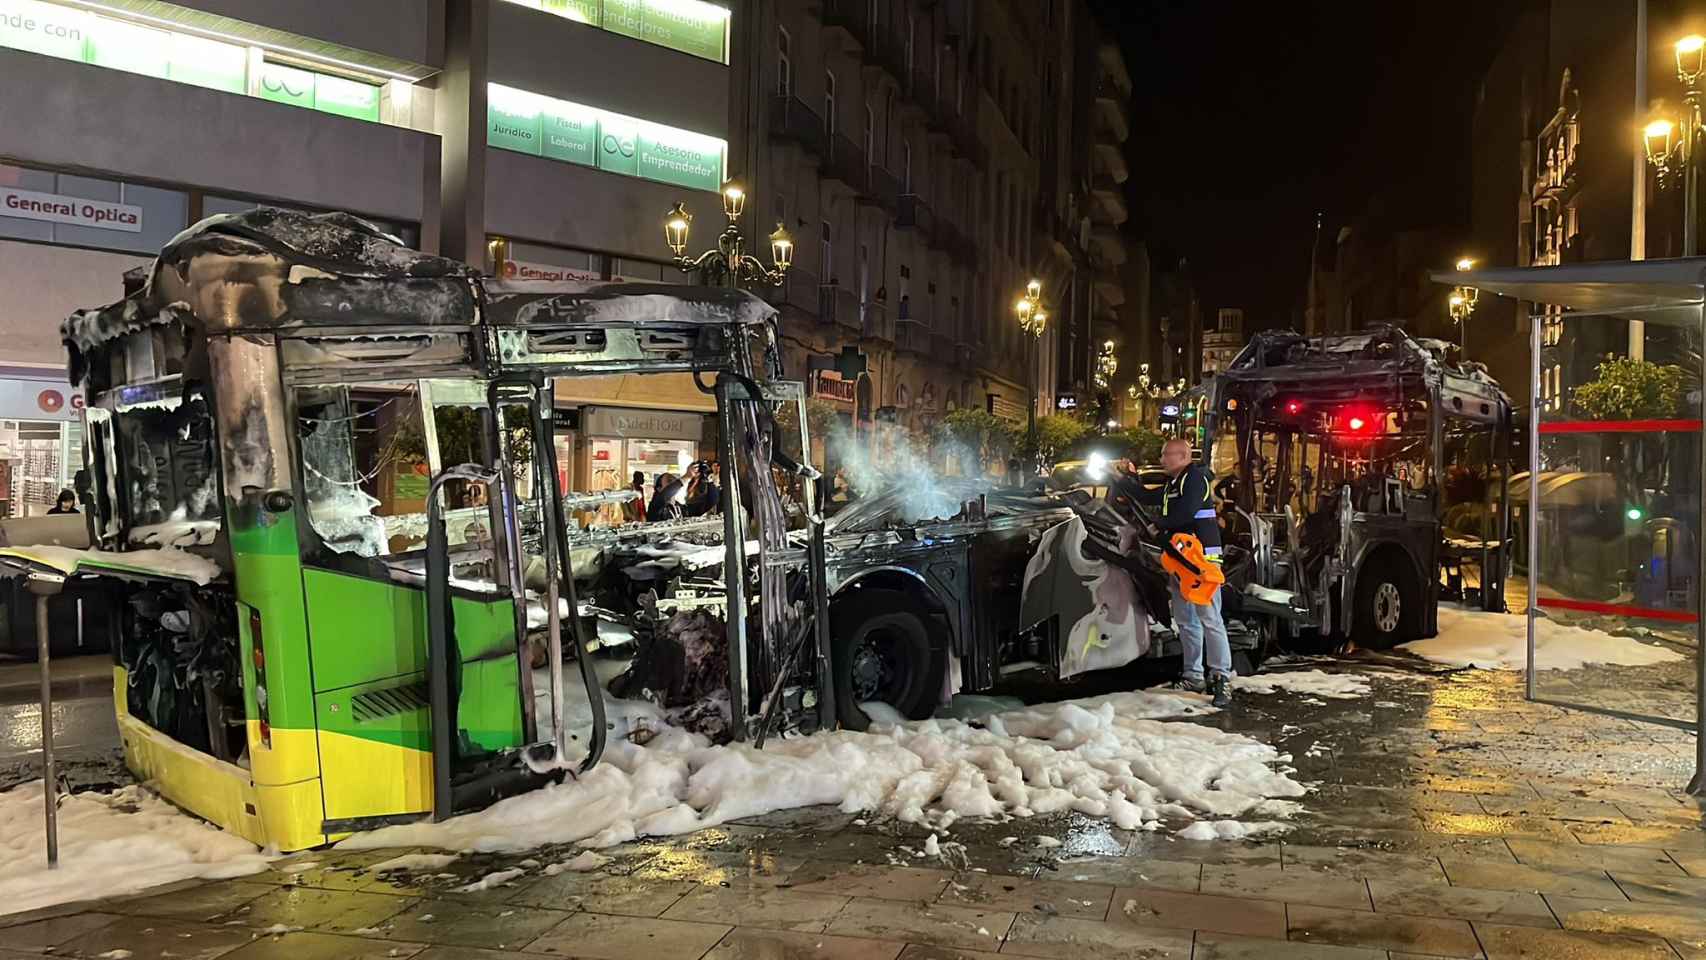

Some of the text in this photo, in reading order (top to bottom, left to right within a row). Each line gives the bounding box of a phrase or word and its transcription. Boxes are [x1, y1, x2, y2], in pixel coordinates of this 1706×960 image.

[550, 135, 586, 152] Laboral
[6, 194, 137, 224] General Optica
[520, 266, 563, 281] General
